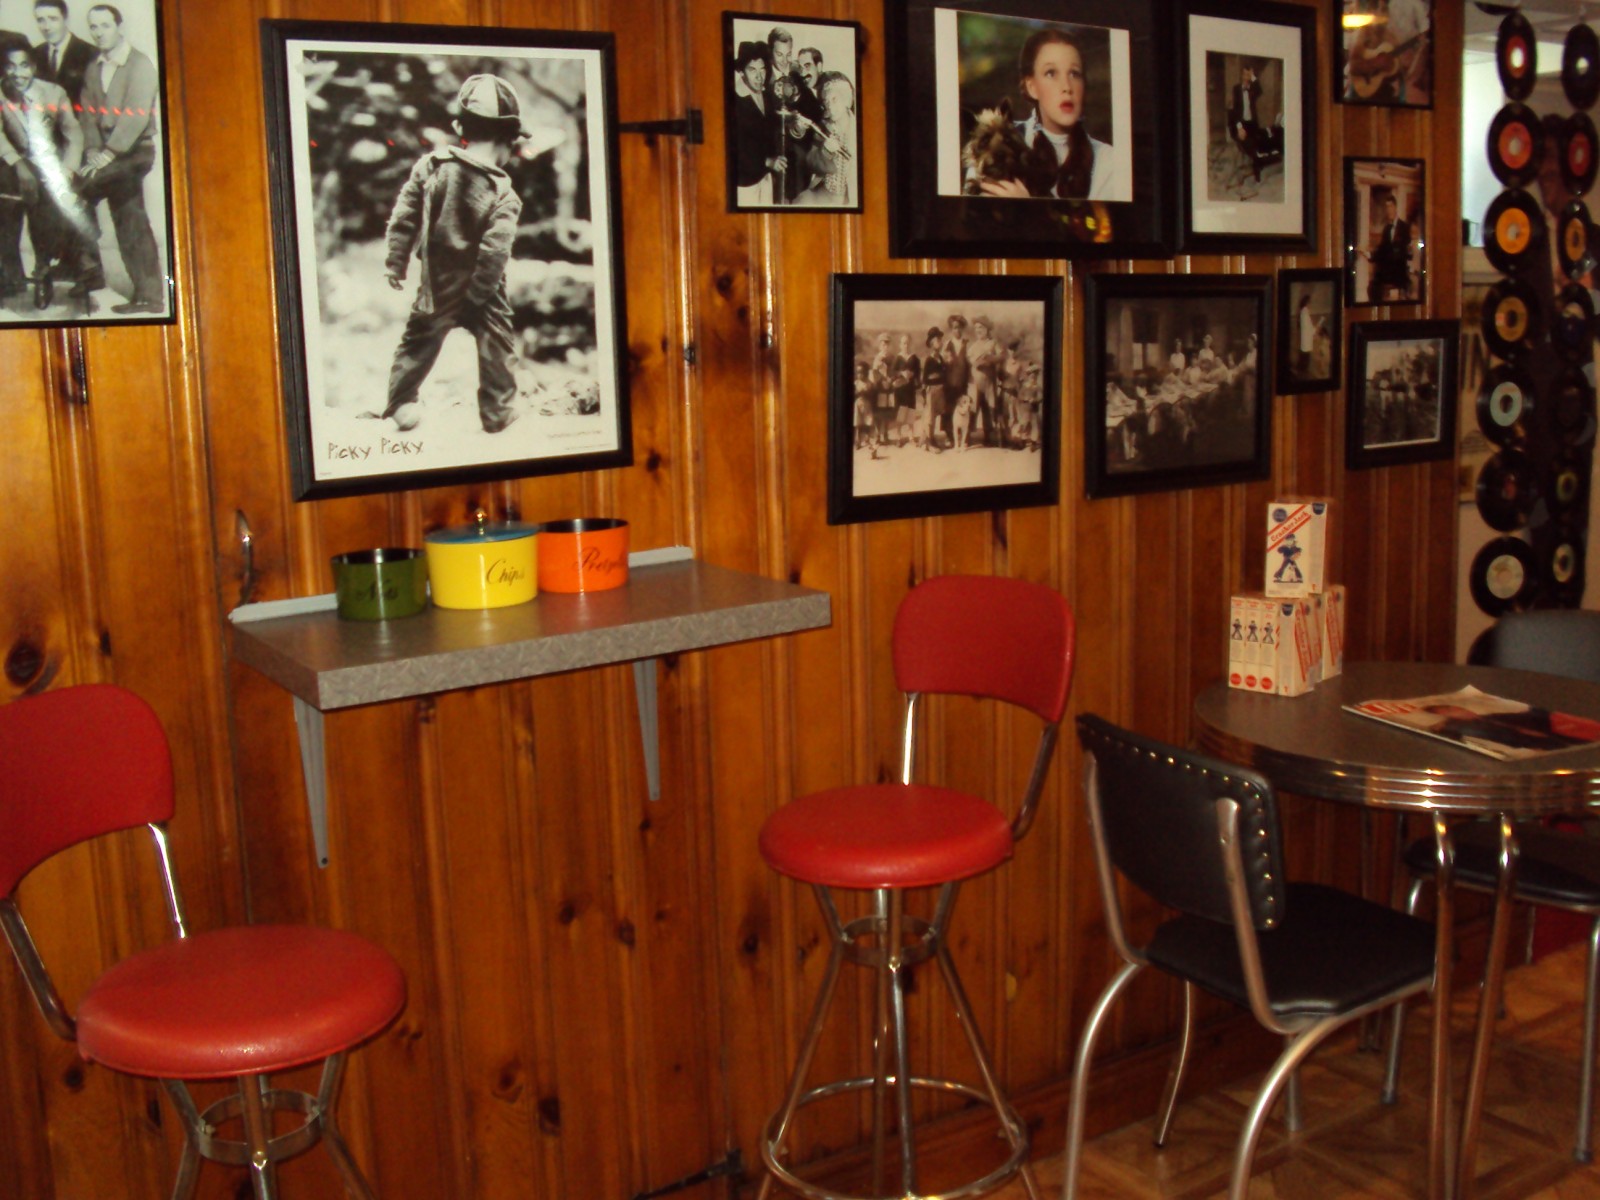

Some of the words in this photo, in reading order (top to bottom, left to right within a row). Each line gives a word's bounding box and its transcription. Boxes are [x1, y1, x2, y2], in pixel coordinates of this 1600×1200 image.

[327, 441, 372, 460] Picky
[380, 436, 424, 456] Picky
[486, 558, 526, 587] Chips
